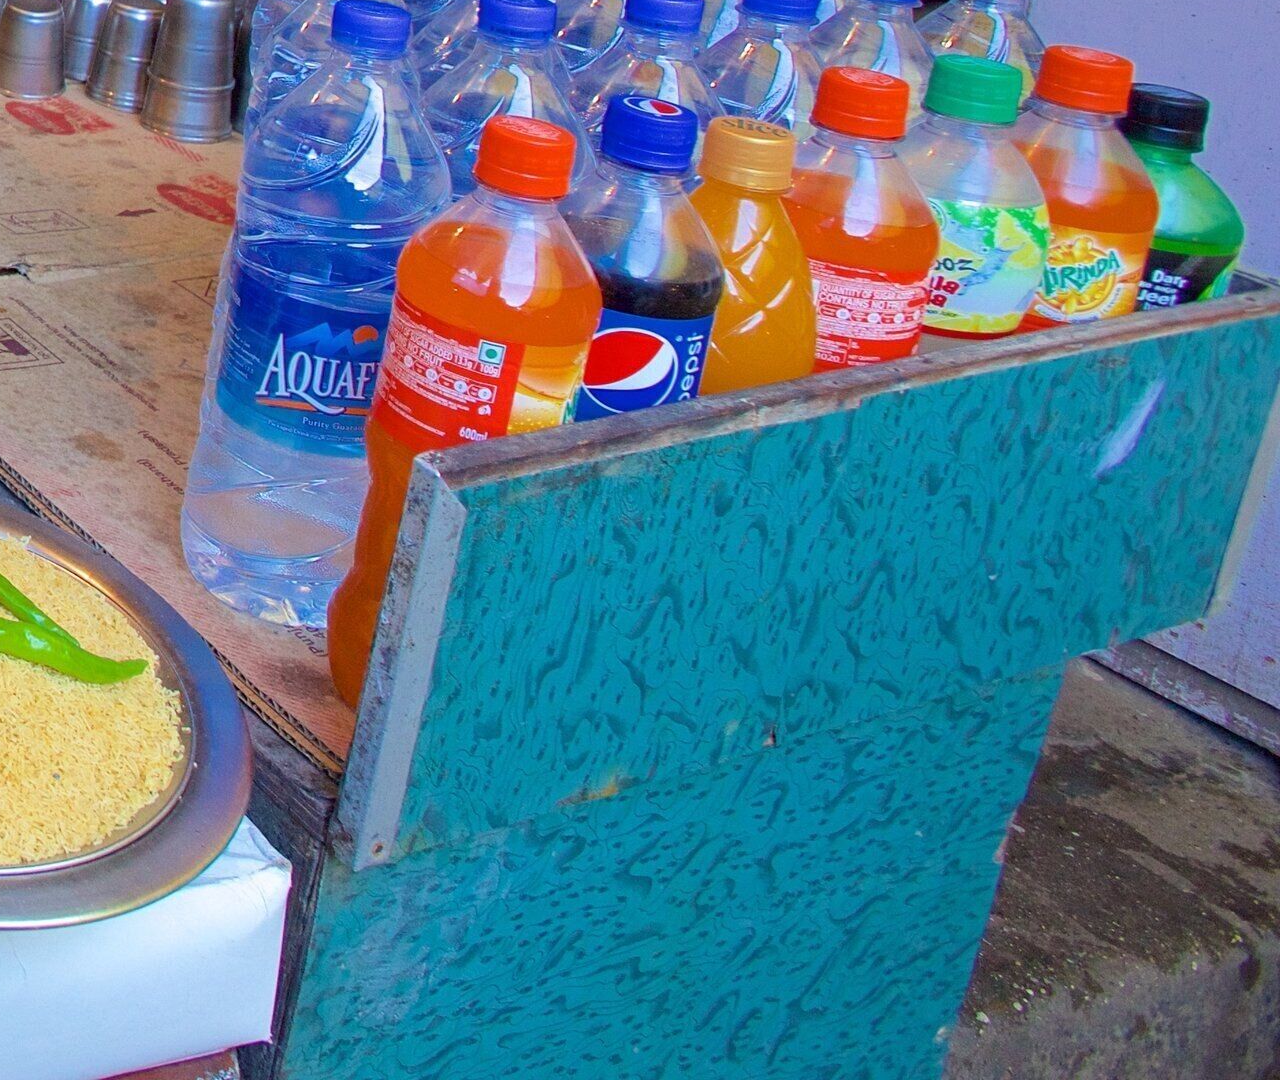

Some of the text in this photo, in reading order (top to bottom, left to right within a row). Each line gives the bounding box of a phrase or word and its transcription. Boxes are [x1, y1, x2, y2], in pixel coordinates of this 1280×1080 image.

[721, 118, 788, 137] slice
[1152, 269, 1187, 288] Darr
[1137, 289, 1177, 306] Jeet
[429, 343, 454, 360] ADDED
[255, 333, 381, 415] AQUAF
[302, 417, 330, 430] Purity
[459, 426, 488, 442] 600ml
